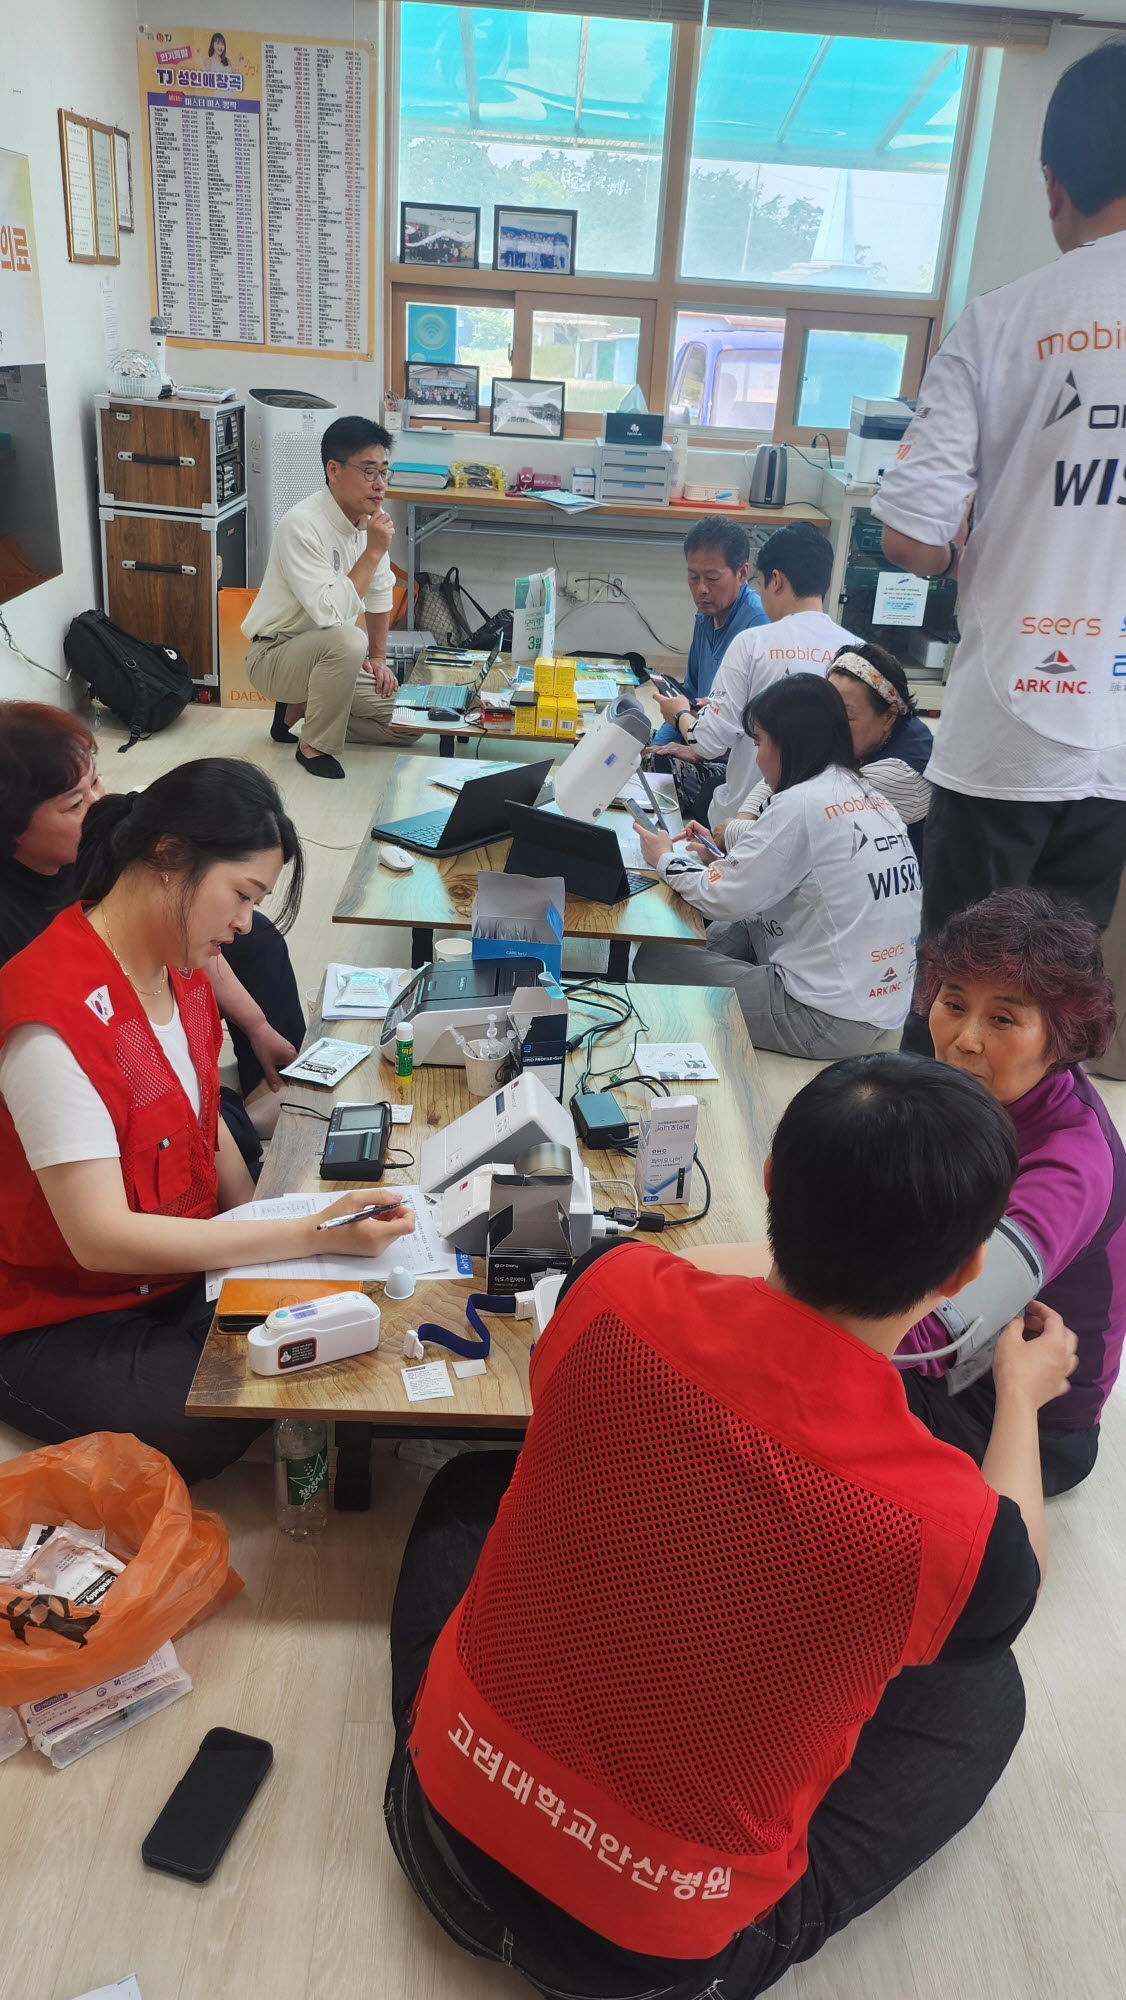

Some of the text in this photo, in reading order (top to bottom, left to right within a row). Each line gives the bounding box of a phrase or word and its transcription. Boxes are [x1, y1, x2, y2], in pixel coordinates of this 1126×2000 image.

[156, 69, 241, 89] TJ 성인애창곡
[185, 98, 205, 107] 미스터
[207, 99, 220, 108] 미스
[1, 225, 31, 272] 의료
[1037, 321, 1126, 360] mobi
[1088, 405, 1126, 429] O
[1020, 617, 1102, 636] seers
[1013, 678, 1051, 694] ARK
[1056, 680, 1092, 695] INC.
[871, 943, 905, 962] seers
[869, 986, 888, 997] ARK
[86, 1576, 116, 1602] CareBuddy
[447, 1711, 733, 1900] 고려대학교안산병원
